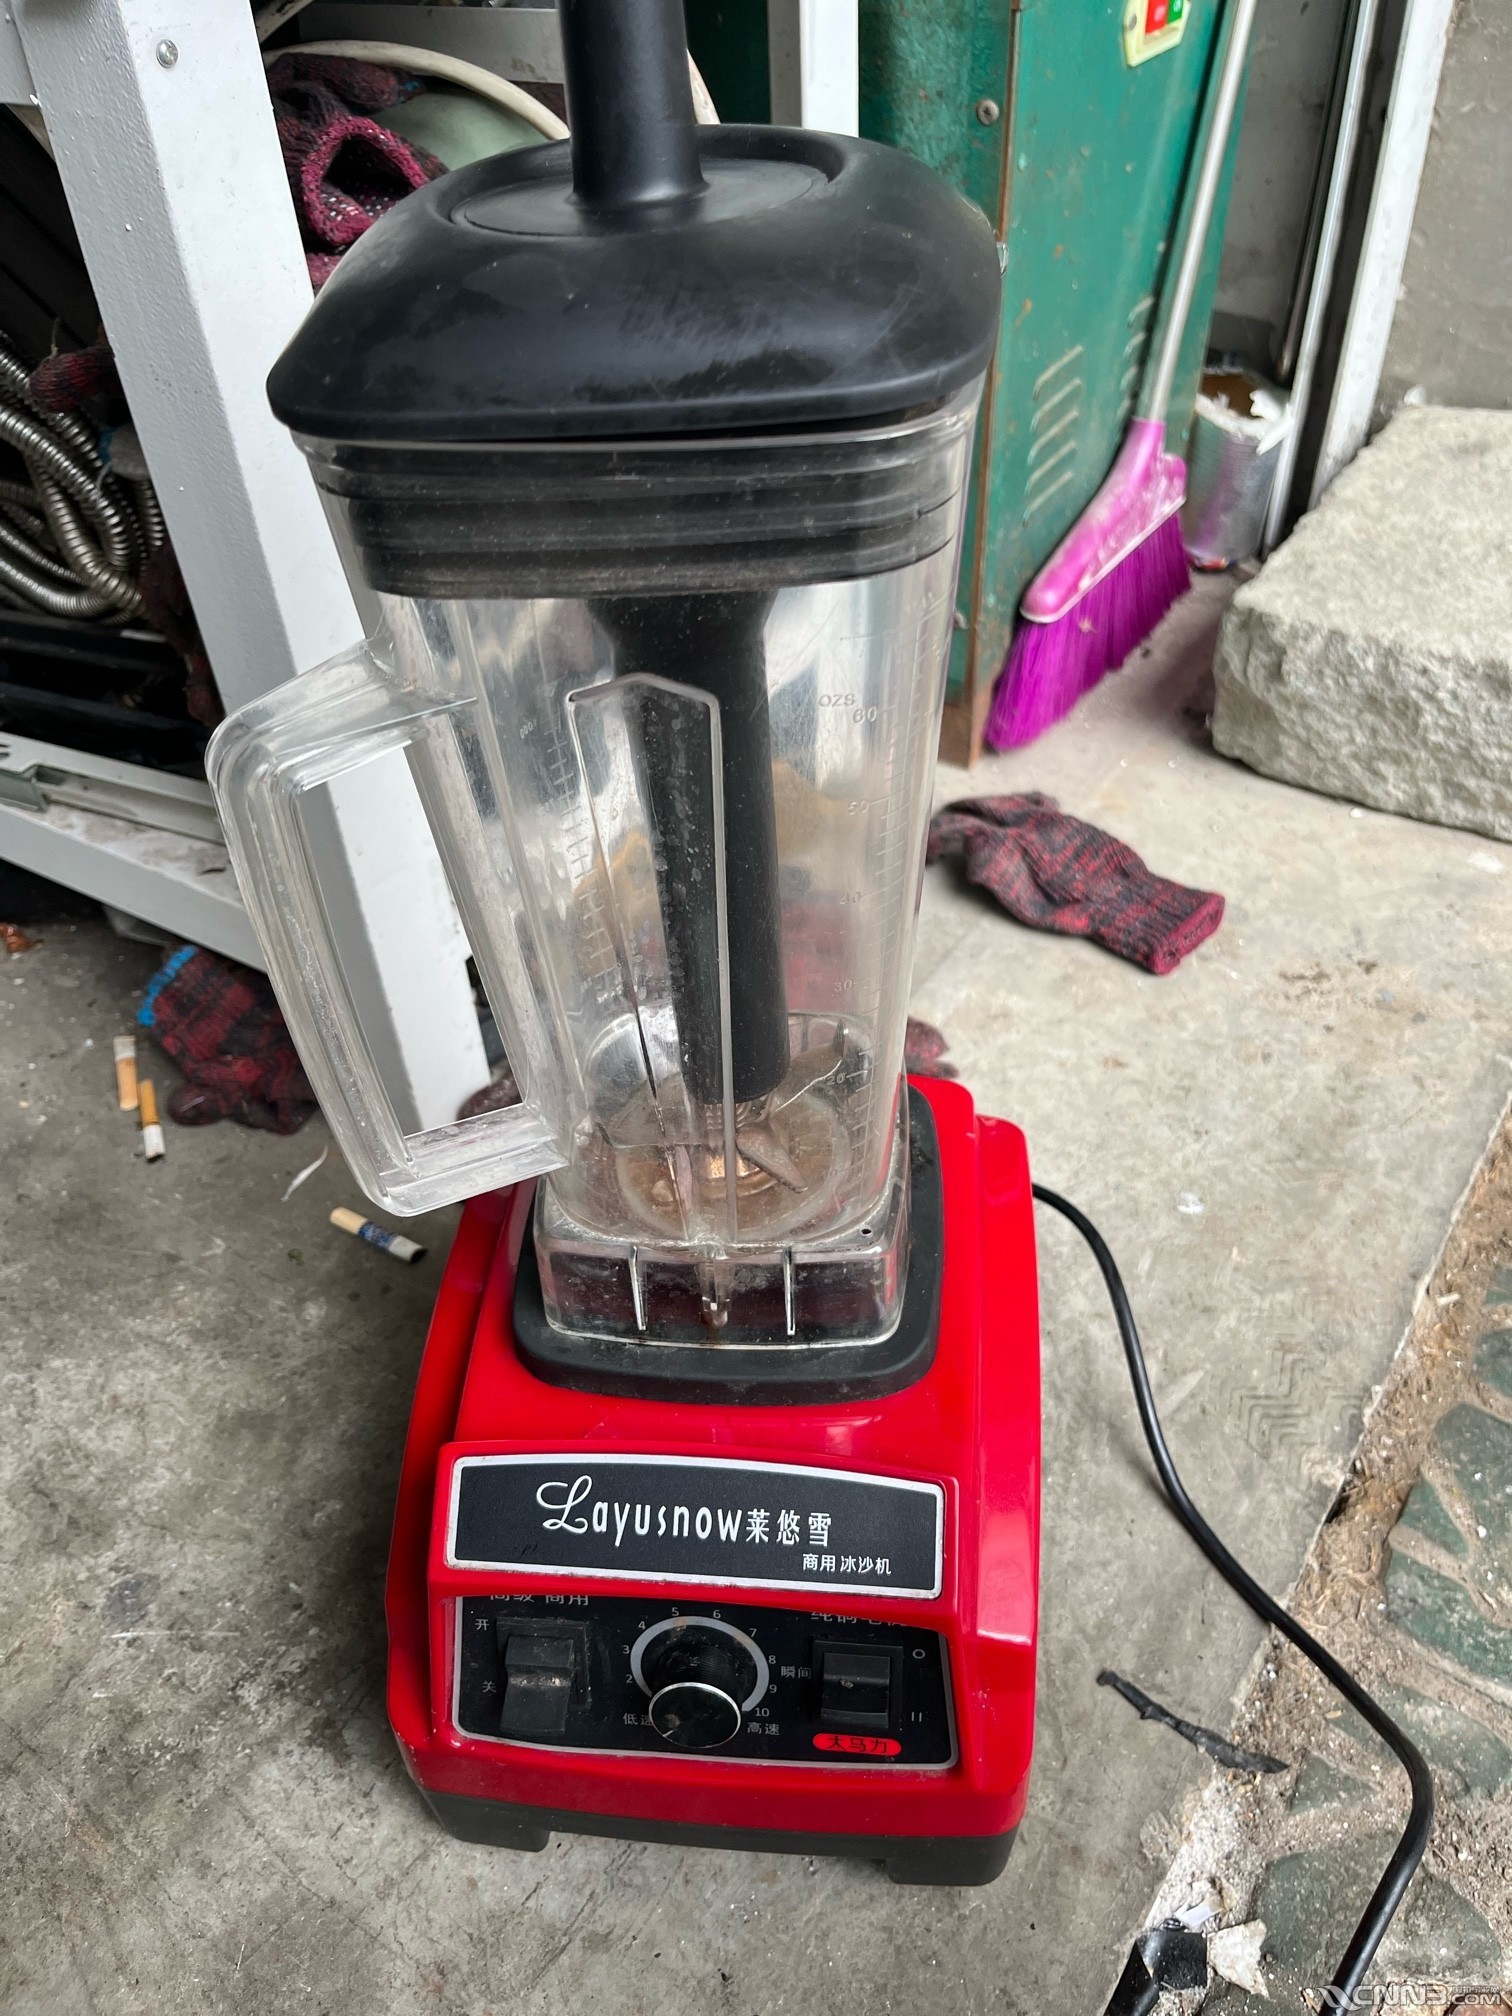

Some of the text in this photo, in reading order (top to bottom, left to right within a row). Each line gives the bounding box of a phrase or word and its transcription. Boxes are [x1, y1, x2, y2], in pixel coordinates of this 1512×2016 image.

[818, 693, 855, 707] OZS
[671, 1607, 680, 1617] 5
[713, 1609, 721, 1619] 6
[475, 1618, 490, 1631] 开
[638, 1620, 646, 1630] 4
[749, 1627, 757, 1638] 7
[622, 1644, 630, 1655] 3
[768, 1655, 776, 1665] 8
[625, 1675, 633, 1685] 2
[482, 1680, 497, 1693] 关
[769, 1684, 777, 1694] 9
[755, 1707, 770, 1717] 10
[746, 1721, 780, 1736] 高速
[826, 1735, 888, 1754] 大马力
